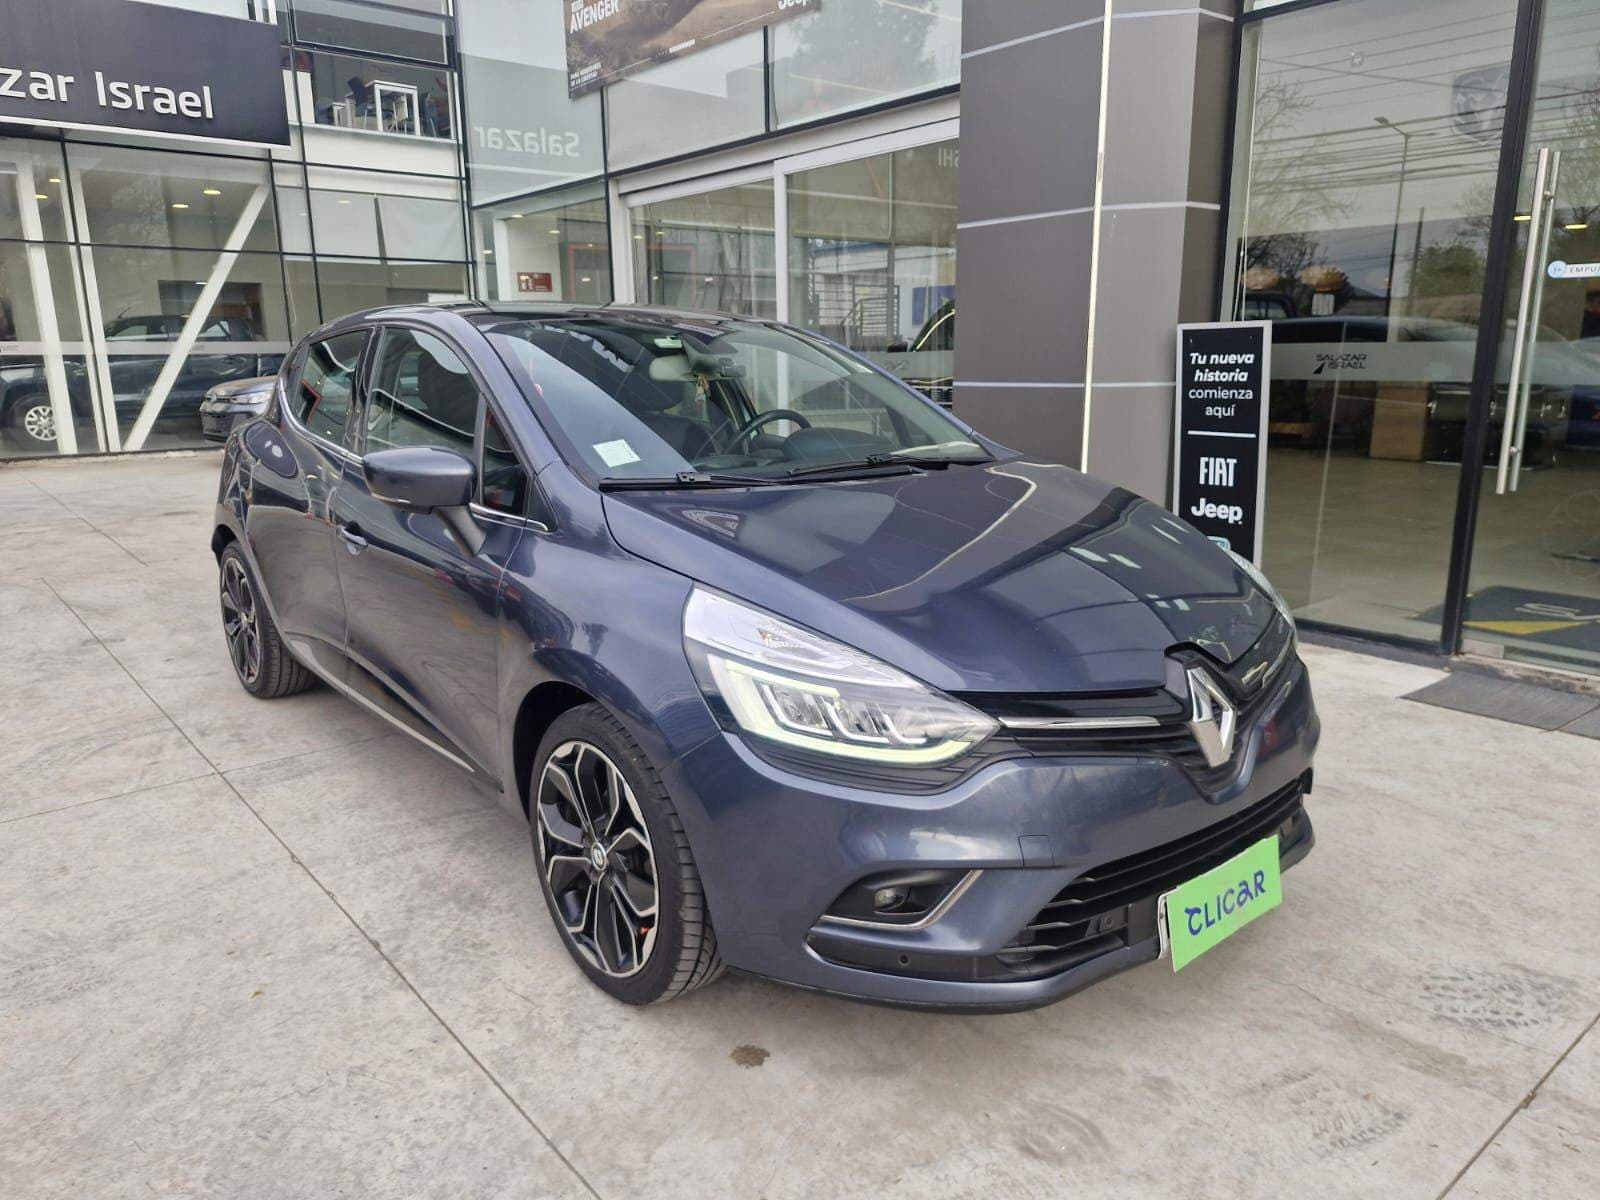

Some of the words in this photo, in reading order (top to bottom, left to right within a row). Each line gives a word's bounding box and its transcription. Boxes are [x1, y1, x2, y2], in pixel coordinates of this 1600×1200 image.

[570, 0, 619, 34] AVENGER
[0, 67, 75, 102] zar
[95, 71, 214, 119] Israel
[1569, 264, 1600, 273] EMPU
[1190, 352, 1207, 365] Tu
[1209, 353, 1255, 364] nueva
[1194, 368, 1249, 382] historia
[1188, 386, 1254, 399] comienza
[1204, 404, 1236, 418] aquí
[1199, 456, 1238, 487] FIAT
[1190, 497, 1243, 525] Jeep
